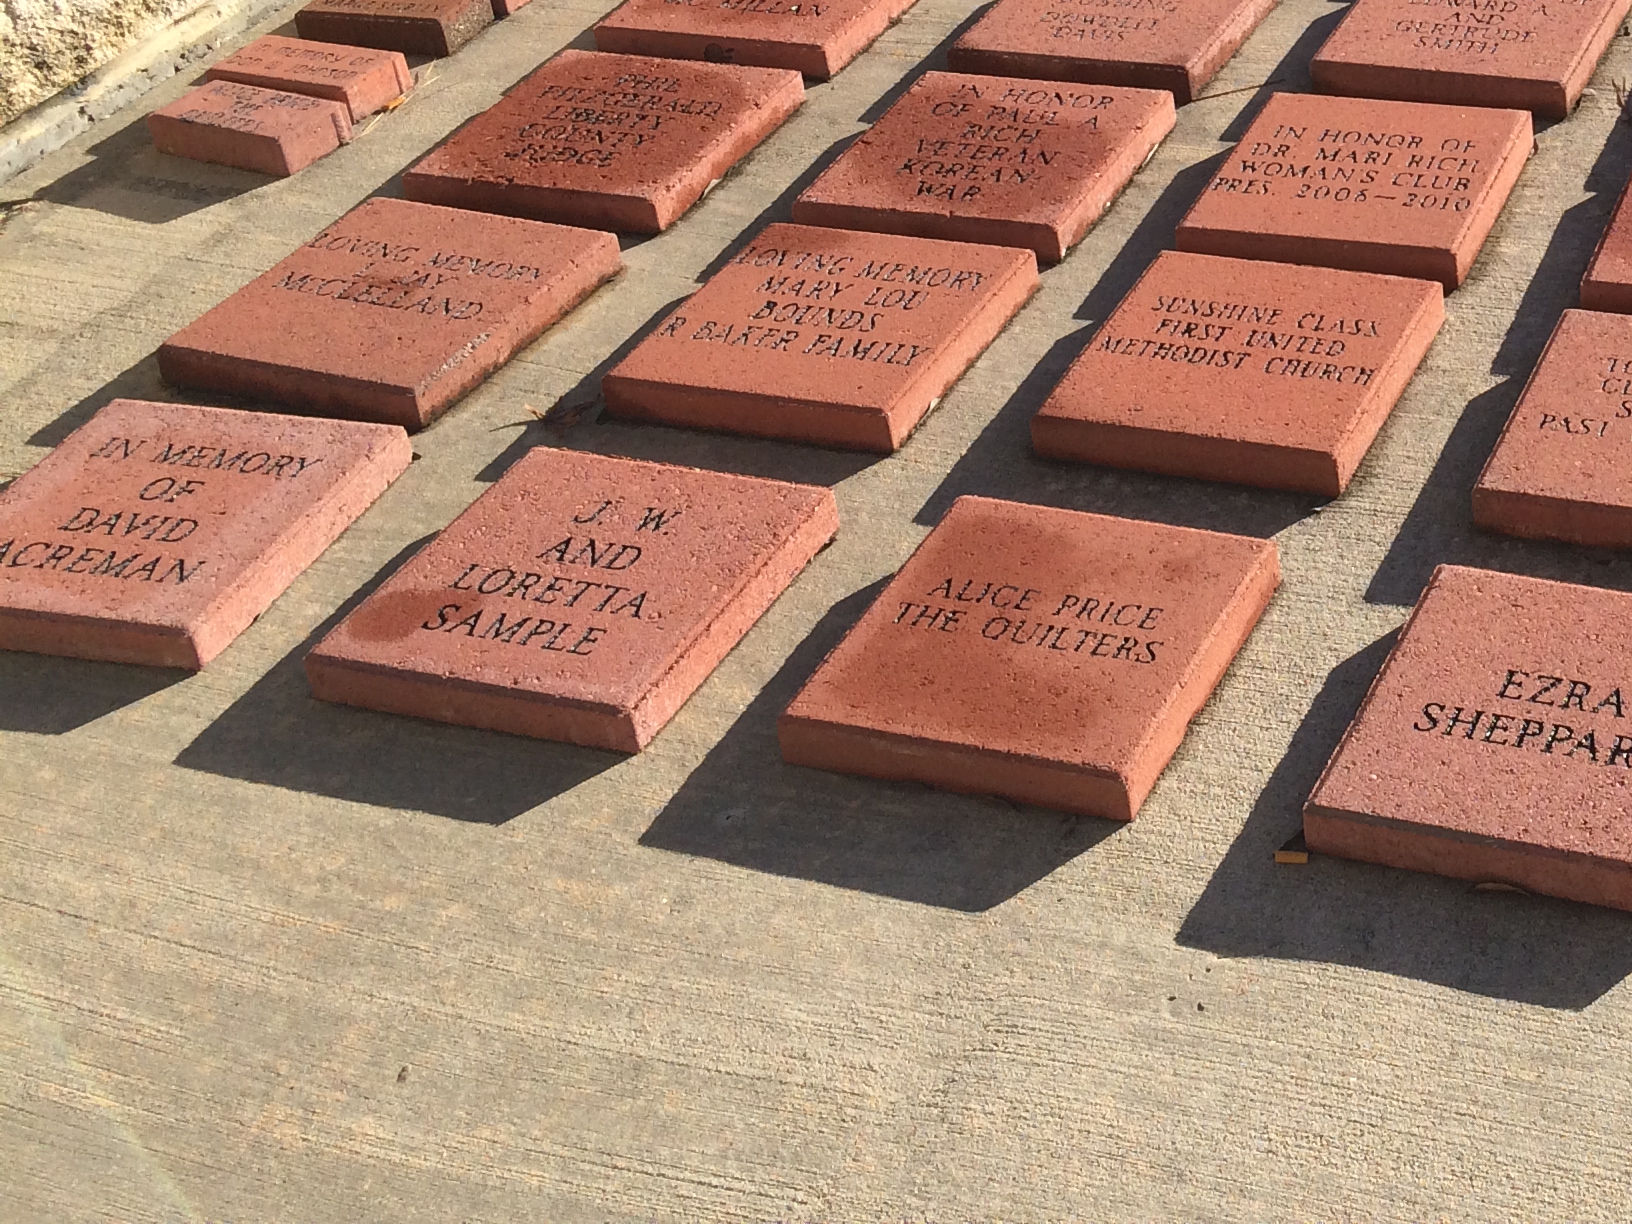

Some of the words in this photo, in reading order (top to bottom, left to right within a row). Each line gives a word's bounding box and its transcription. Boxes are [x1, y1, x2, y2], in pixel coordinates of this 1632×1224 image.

[1395, 19, 1538, 43] GERTRUDE
[1444, 12, 1504, 25] AND
[1414, 36, 1499, 54] SMITH
[1272, 125, 1308, 141] IN
[1318, 129, 1424, 150] HONOR
[1441, 138, 1478, 153] OF
[1315, 147, 1394, 167] MARI
[1406, 155, 1480, 173] RICH
[1391, 172, 1473, 192] CLUB
[736, 246, 853, 276] LOVING
[855, 260, 995, 292] MEMORY
[756, 276, 854, 301] MARY
[865, 286, 930, 311] LOU
[751, 300, 886, 332] BOUNDS
[1151, 295, 1283, 326] SUNSHINE
[1297, 312, 1382, 338] CLASS
[691, 321, 800, 352] BAKER
[803, 334, 933, 366] FAMILY
[1154, 318, 1233, 343] FIRST
[1244, 330, 1346, 357] UNITED
[1096, 335, 1252, 369] METHODIST
[1264, 357, 1380, 385] CHURCH
[1539, 413, 1609, 436] PAST
[90, 436, 147, 460] IN
[150, 442, 324, 477] MEMORY
[138, 477, 205, 503] OF
[57, 507, 199, 543] DAVID
[571, 501, 612, 526] J.
[636, 507, 682, 536] W.
[538, 537, 641, 572] AND
[450, 564, 648, 621] LORETTA
[927, 578, 1041, 612] ALICE
[1053, 594, 1164, 630] PRICE
[421, 603, 606, 657] SAMPLE
[893, 602, 967, 632] THE
[980, 617, 1164, 664] QUILTERS
[1496, 669, 1626, 718] EZRA
